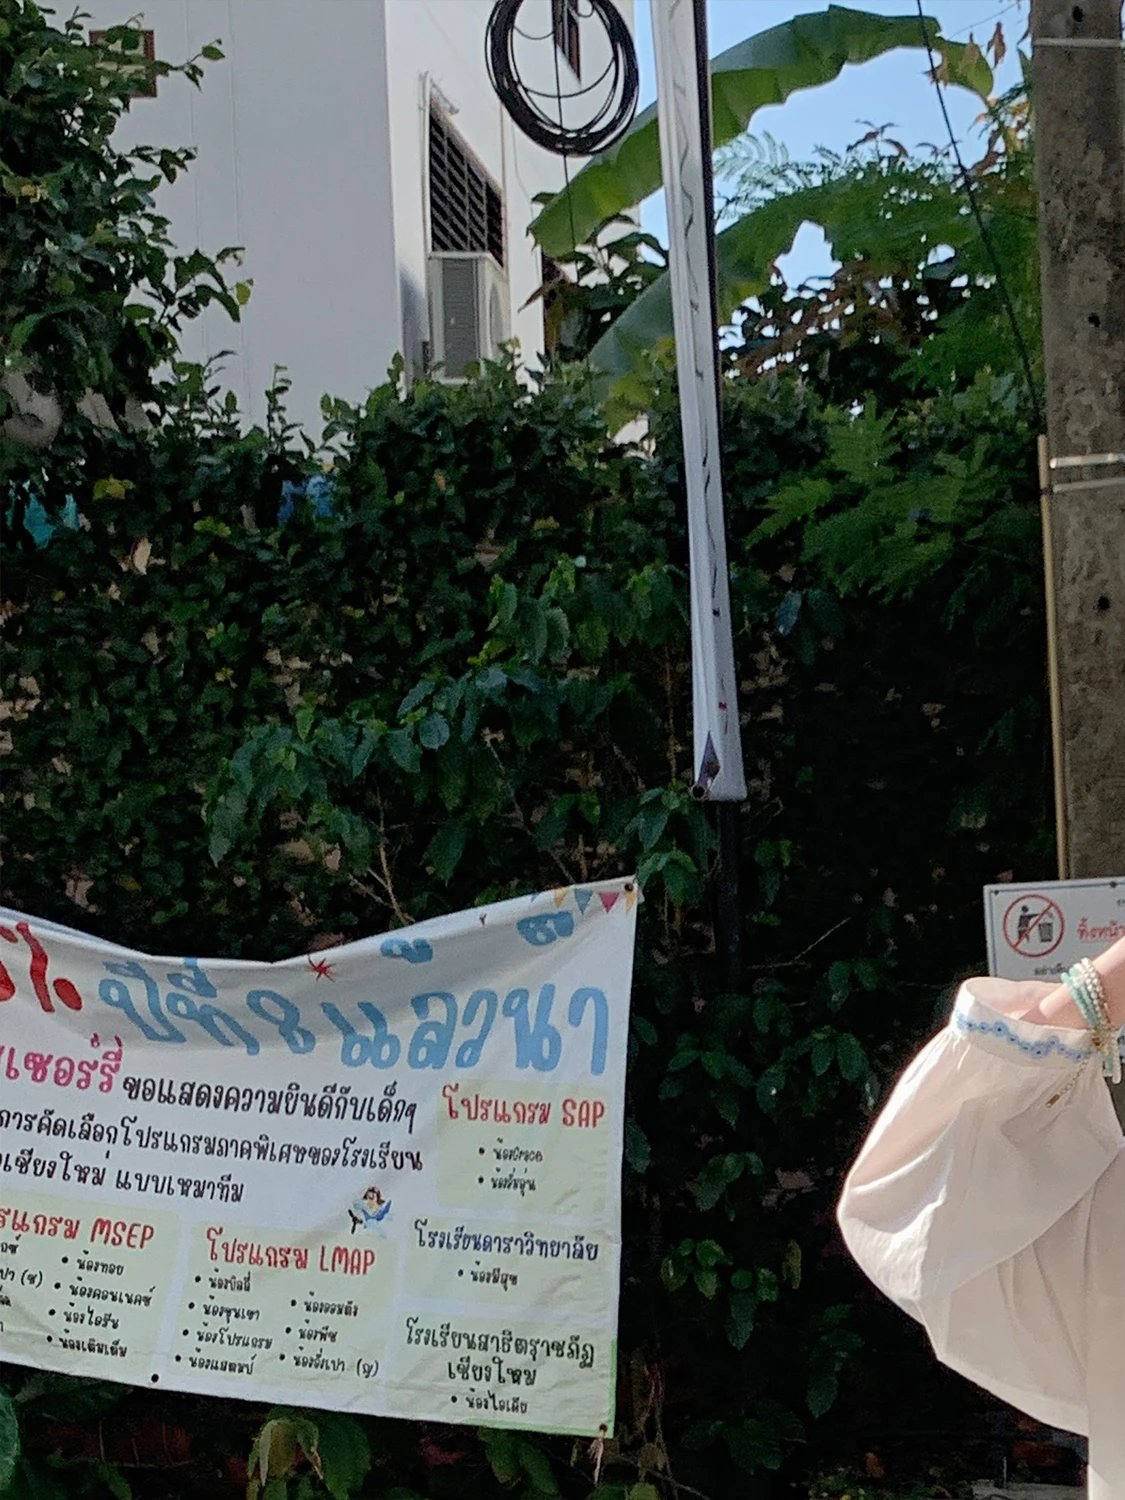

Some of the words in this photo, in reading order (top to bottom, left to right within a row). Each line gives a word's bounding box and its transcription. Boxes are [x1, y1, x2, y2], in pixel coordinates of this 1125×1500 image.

[0, 1032, 123, 1093] เซอร์รี่
[123, 1076, 418, 1134] ขอแสดงความยินดีกับเด็กๆ
[442, 1083, 551, 1125] โปรแกรม
[562, 1099, 605, 1128] SAP
[0, 1148, 110, 1186] เชียงใหม่
[115, 1169, 244, 1203] แบบเหมาทีม
[90, 1217, 155, 1250] MSEP
[206, 1227, 308, 1270] โปรแกรม
[319, 1245, 375, 1275] LMAP
[415, 1219, 600, 1261] โรงเรียนดาราวิทยาลัย
